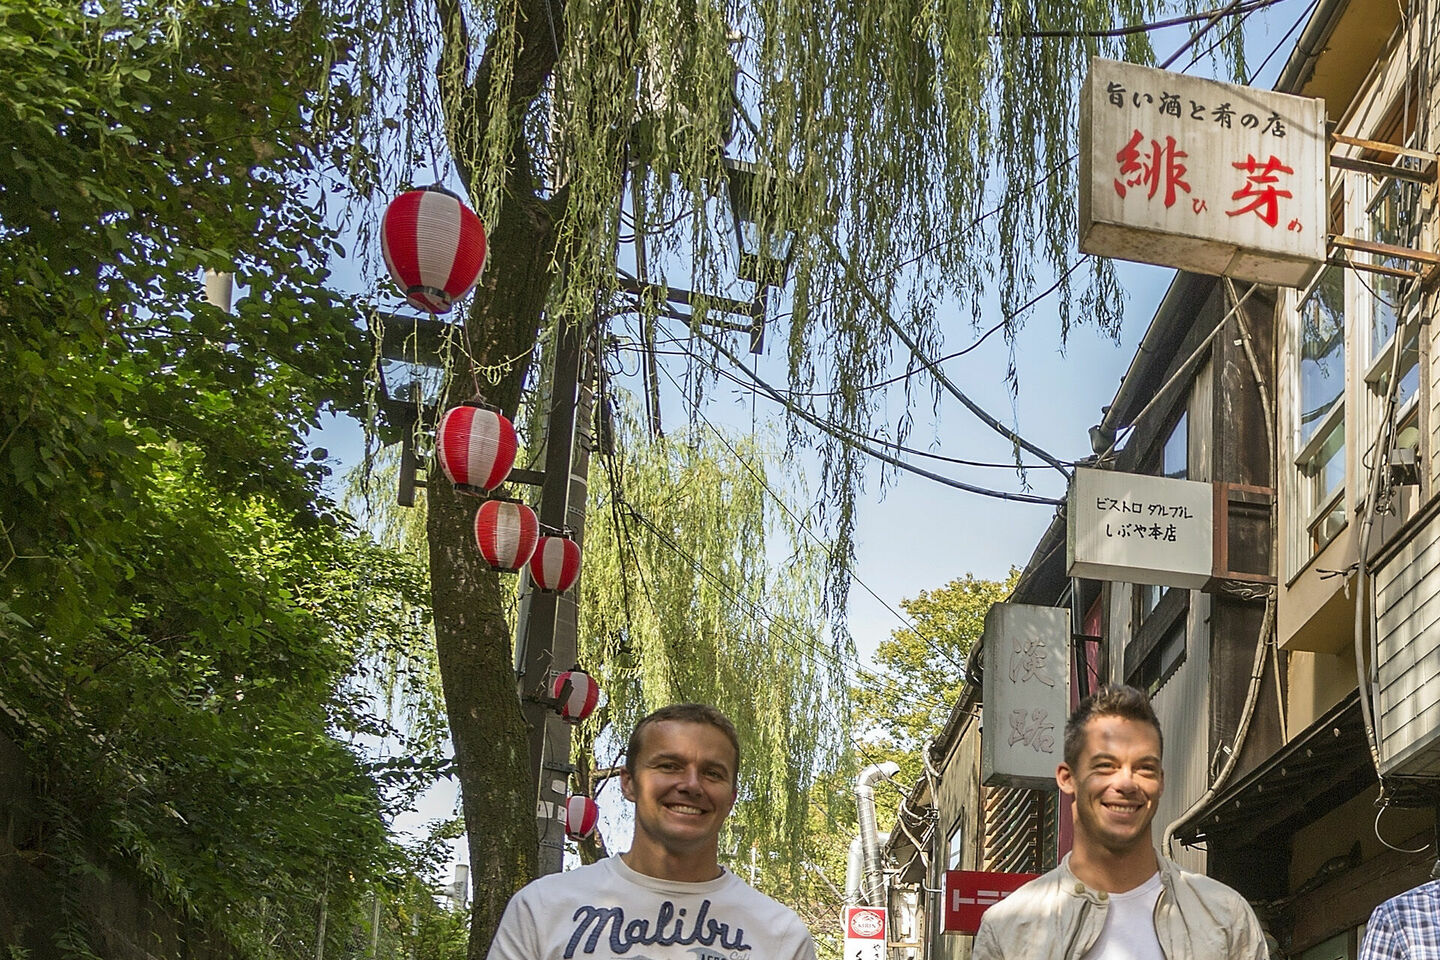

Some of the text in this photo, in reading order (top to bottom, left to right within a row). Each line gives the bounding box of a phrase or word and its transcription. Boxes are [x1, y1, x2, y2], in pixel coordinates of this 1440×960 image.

[1106, 80, 1287, 138] 旨い酒と肴の店
[1096, 497, 1143, 514] ビストロ
[1106, 522, 1177, 542] しぶや本店
[563, 899, 752, 960] Malibu
